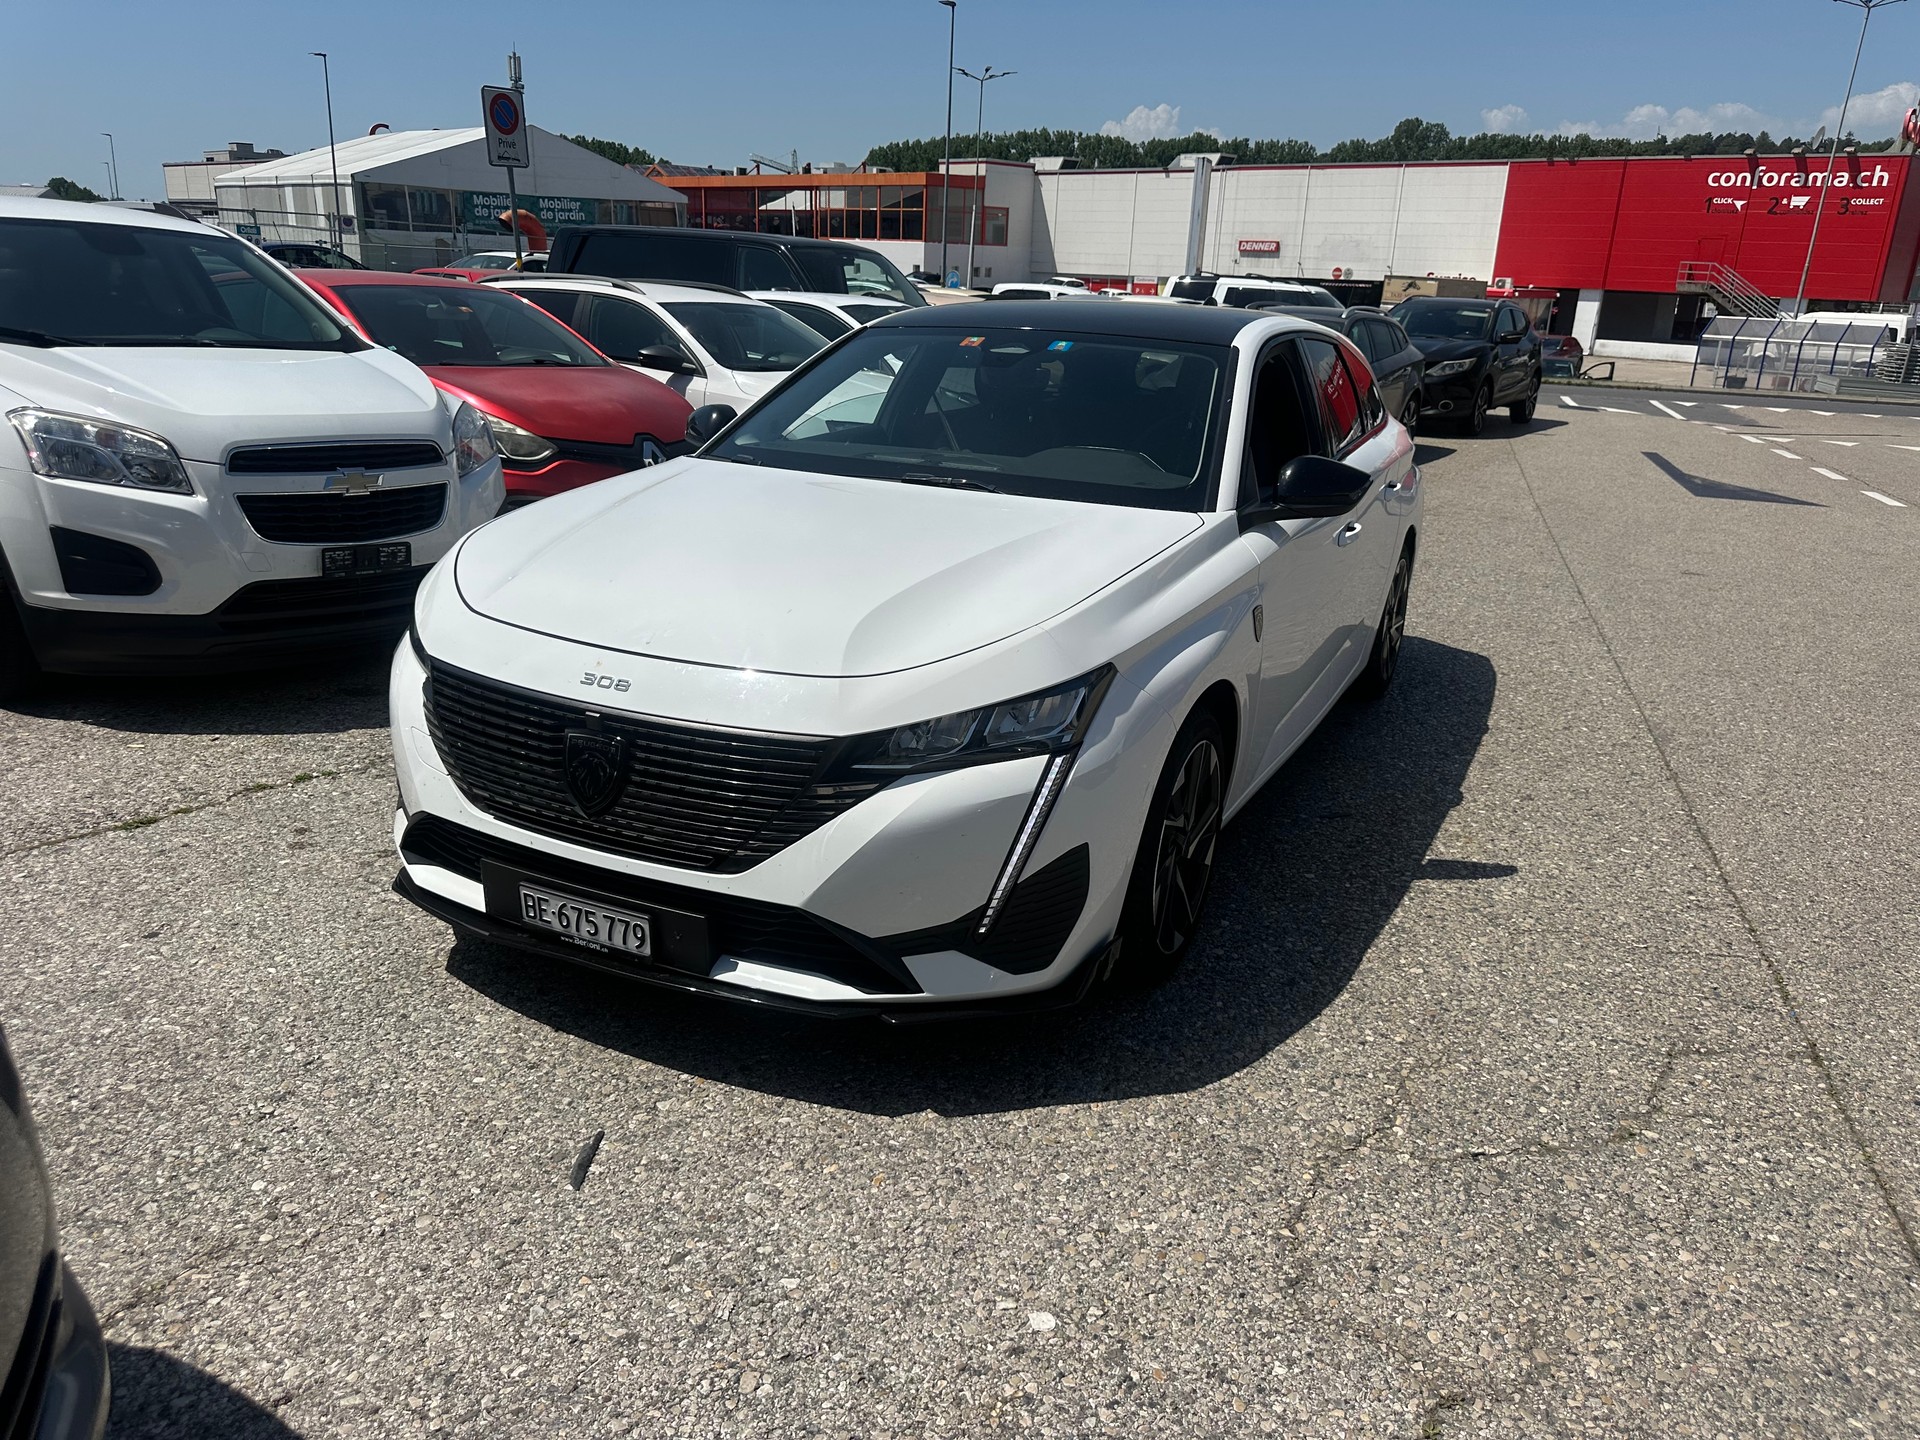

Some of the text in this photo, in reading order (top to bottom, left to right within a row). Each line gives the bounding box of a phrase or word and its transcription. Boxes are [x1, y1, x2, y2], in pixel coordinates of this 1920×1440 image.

[498, 137, 517, 150] Privé
[1707, 165, 1889, 189] conforama.ch
[473, 195, 517, 206] Mobilie
[540, 199, 581, 210] Mobilier
[1713, 197, 1734, 205] CLICK
[1850, 198, 1884, 206] COLLECT
[474, 206, 489, 217] de
[541, 209, 586, 222] de jardin
[1240, 241, 1277, 251] DENNER
[579, 671, 632, 693] 308
